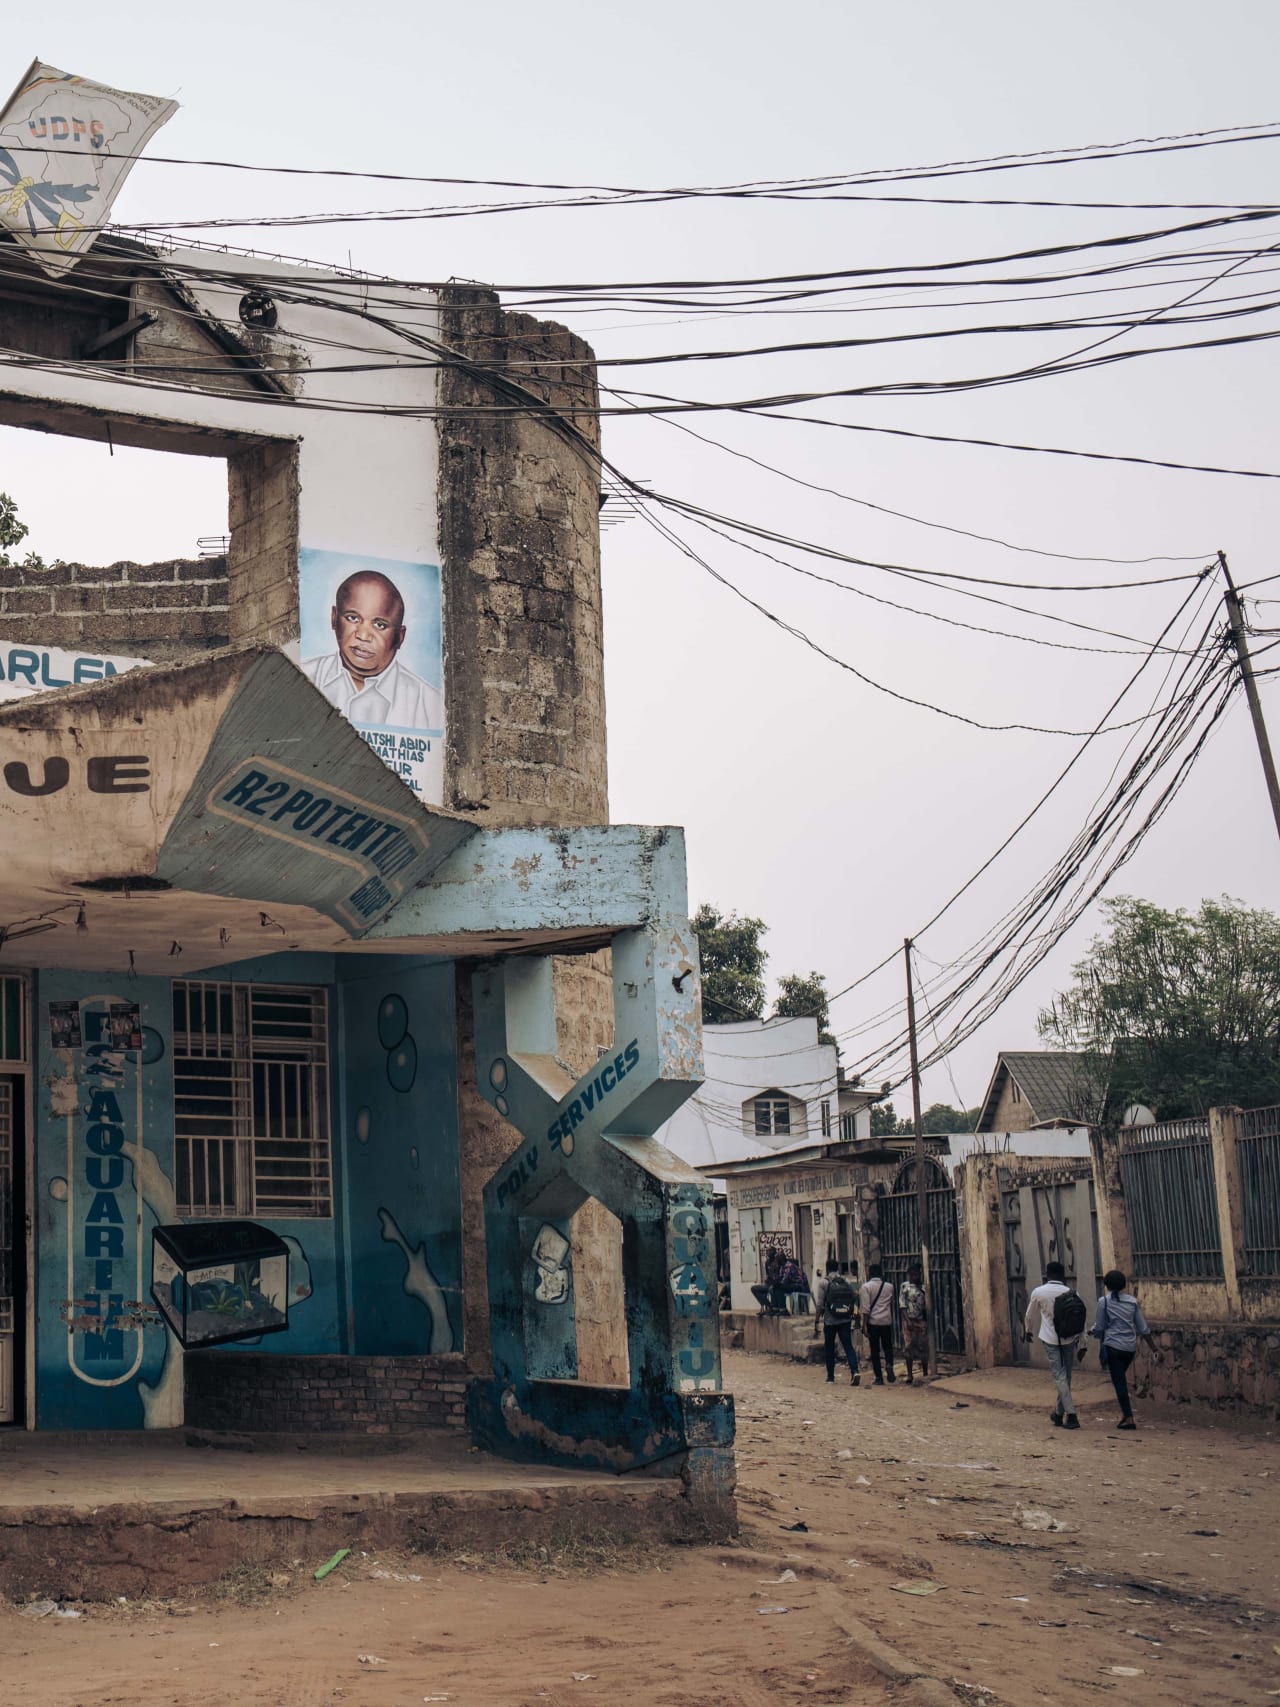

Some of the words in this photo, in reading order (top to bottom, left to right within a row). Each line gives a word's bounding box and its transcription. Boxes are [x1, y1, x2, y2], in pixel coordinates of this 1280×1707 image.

[28, 116, 105, 149] UDPS
[400, 737, 431, 752] ABIDI
[495, 1145, 539, 1209] POLY
[547, 1038, 640, 1152] SERVICES
[760, 1232, 791, 1248] Cyber
